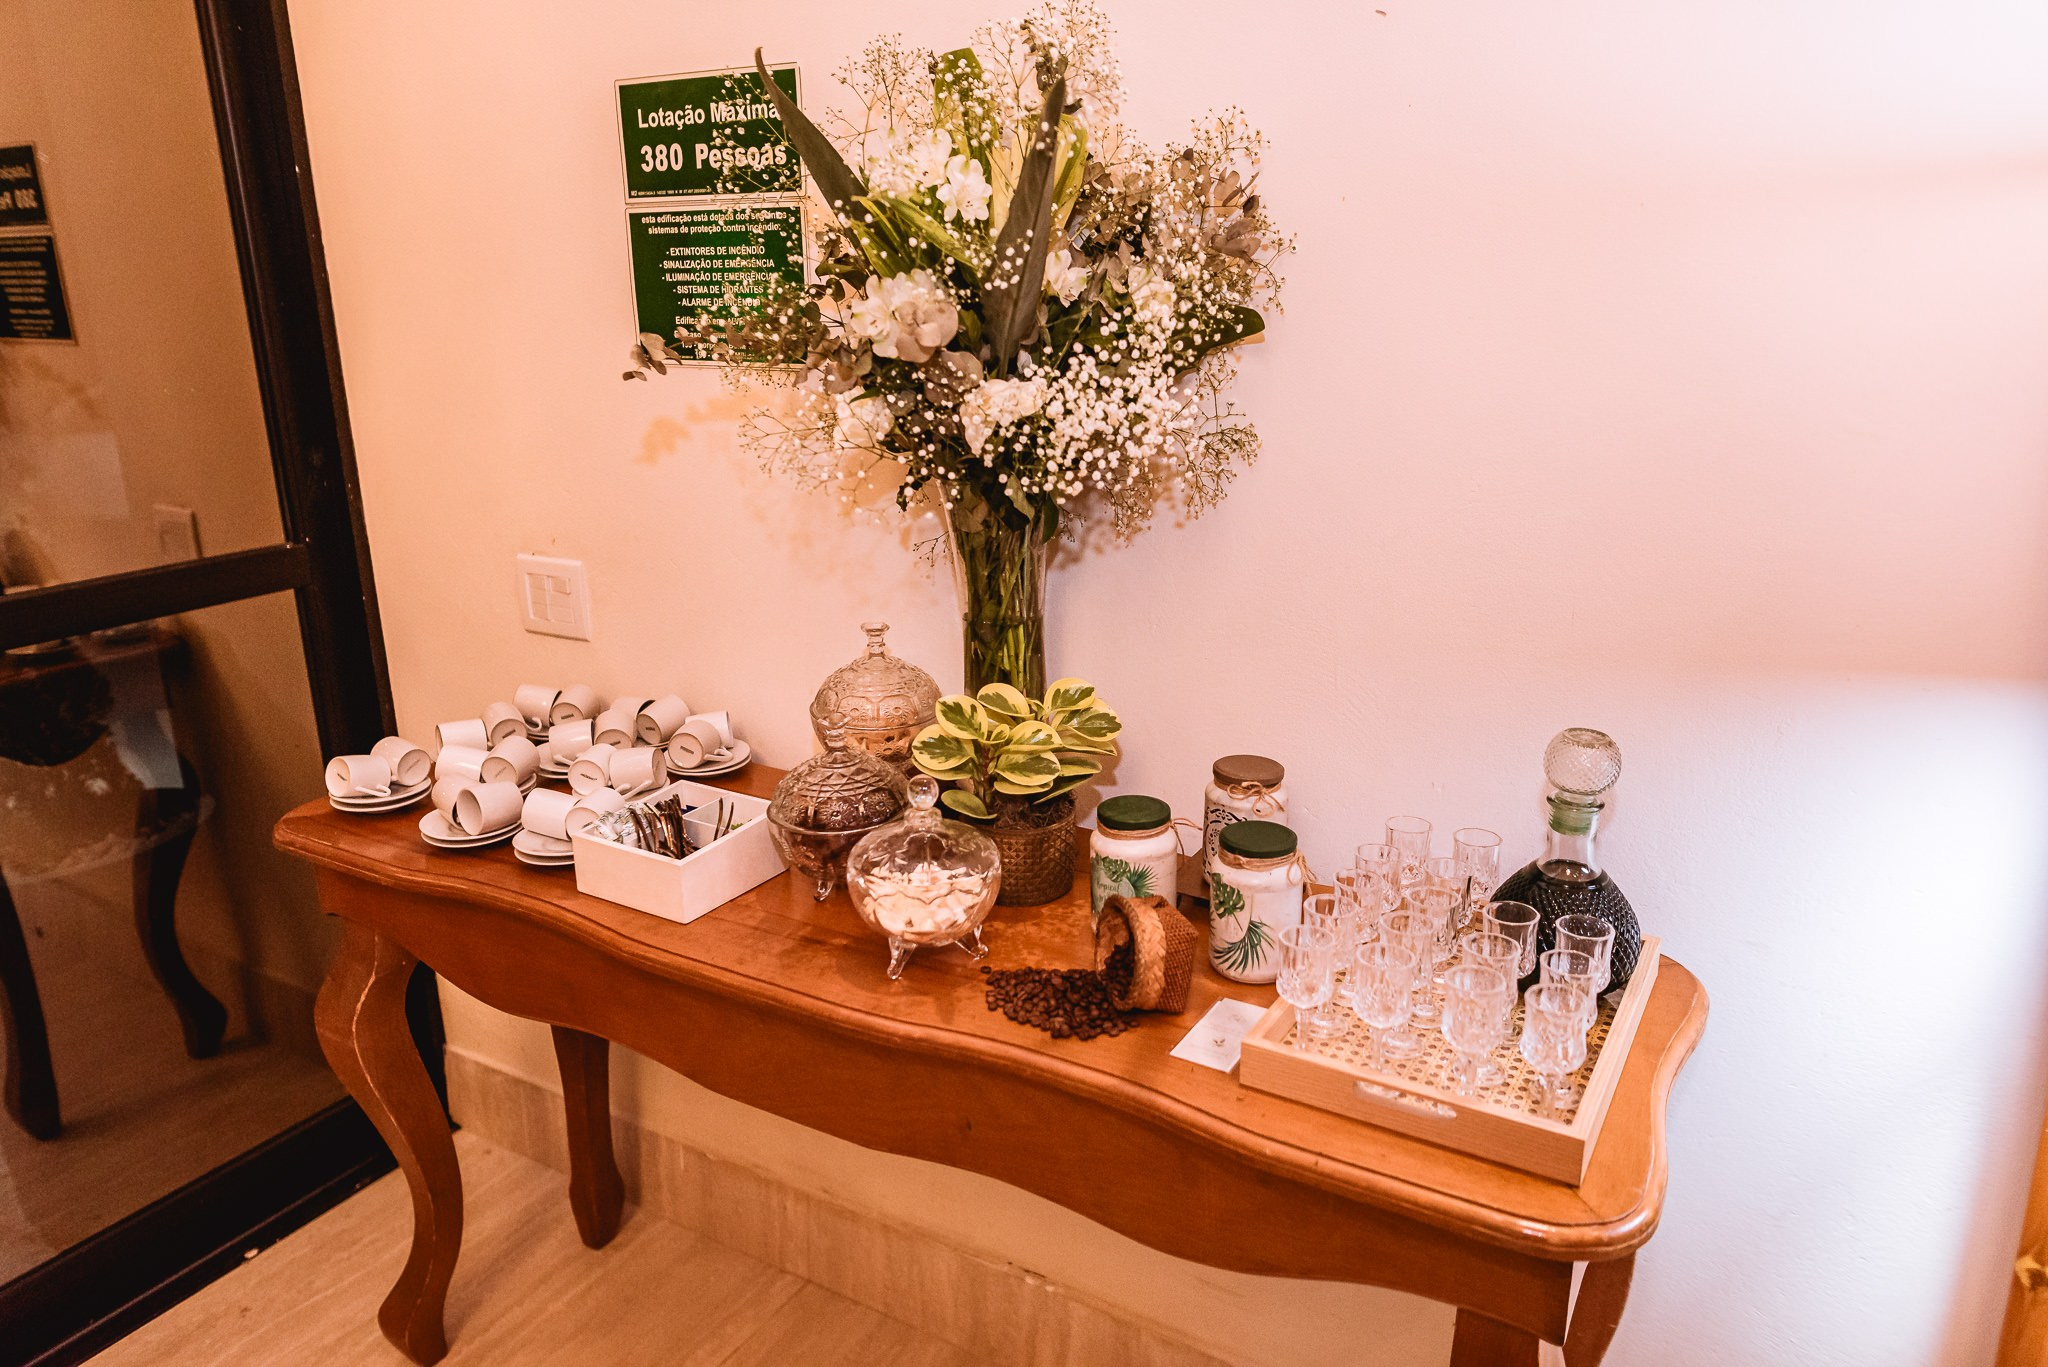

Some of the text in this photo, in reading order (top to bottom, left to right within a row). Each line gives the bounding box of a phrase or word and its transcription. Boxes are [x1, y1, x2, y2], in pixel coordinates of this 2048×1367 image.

[637, 104, 706, 130] Lotação
[640, 143, 787, 172] 380 Pessoas
[641, 215, 656, 224] esta
[656, 213, 692, 225] edificação
[693, 212, 709, 222] está
[735, 211, 750, 221] dos
[648, 225, 679, 235] sistemas
[680, 224, 689, 234] de
[690, 222, 721, 235] proteção
[722, 223, 746, 232] contra
[670, 246, 716, 256] EXTINTORES
[716, 246, 728, 256] DE
[728, 244, 766, 255] INCÊNDIO
[663, 258, 712, 270] SINALIZAÇÃO
[712, 259, 724, 269] DE
[724, 257, 775, 268] EMERGÊNCIA
[665, 271, 711, 283] ILUMINAÇÃO
[712, 272, 723, 281] DE
[676, 285, 709, 294] SISTEMA
[709, 285, 720, 294] DE
[721, 285, 764, 294] HIDRANTES
[681, 297, 712, 307] ALARME
[713, 297, 724, 307] DE
